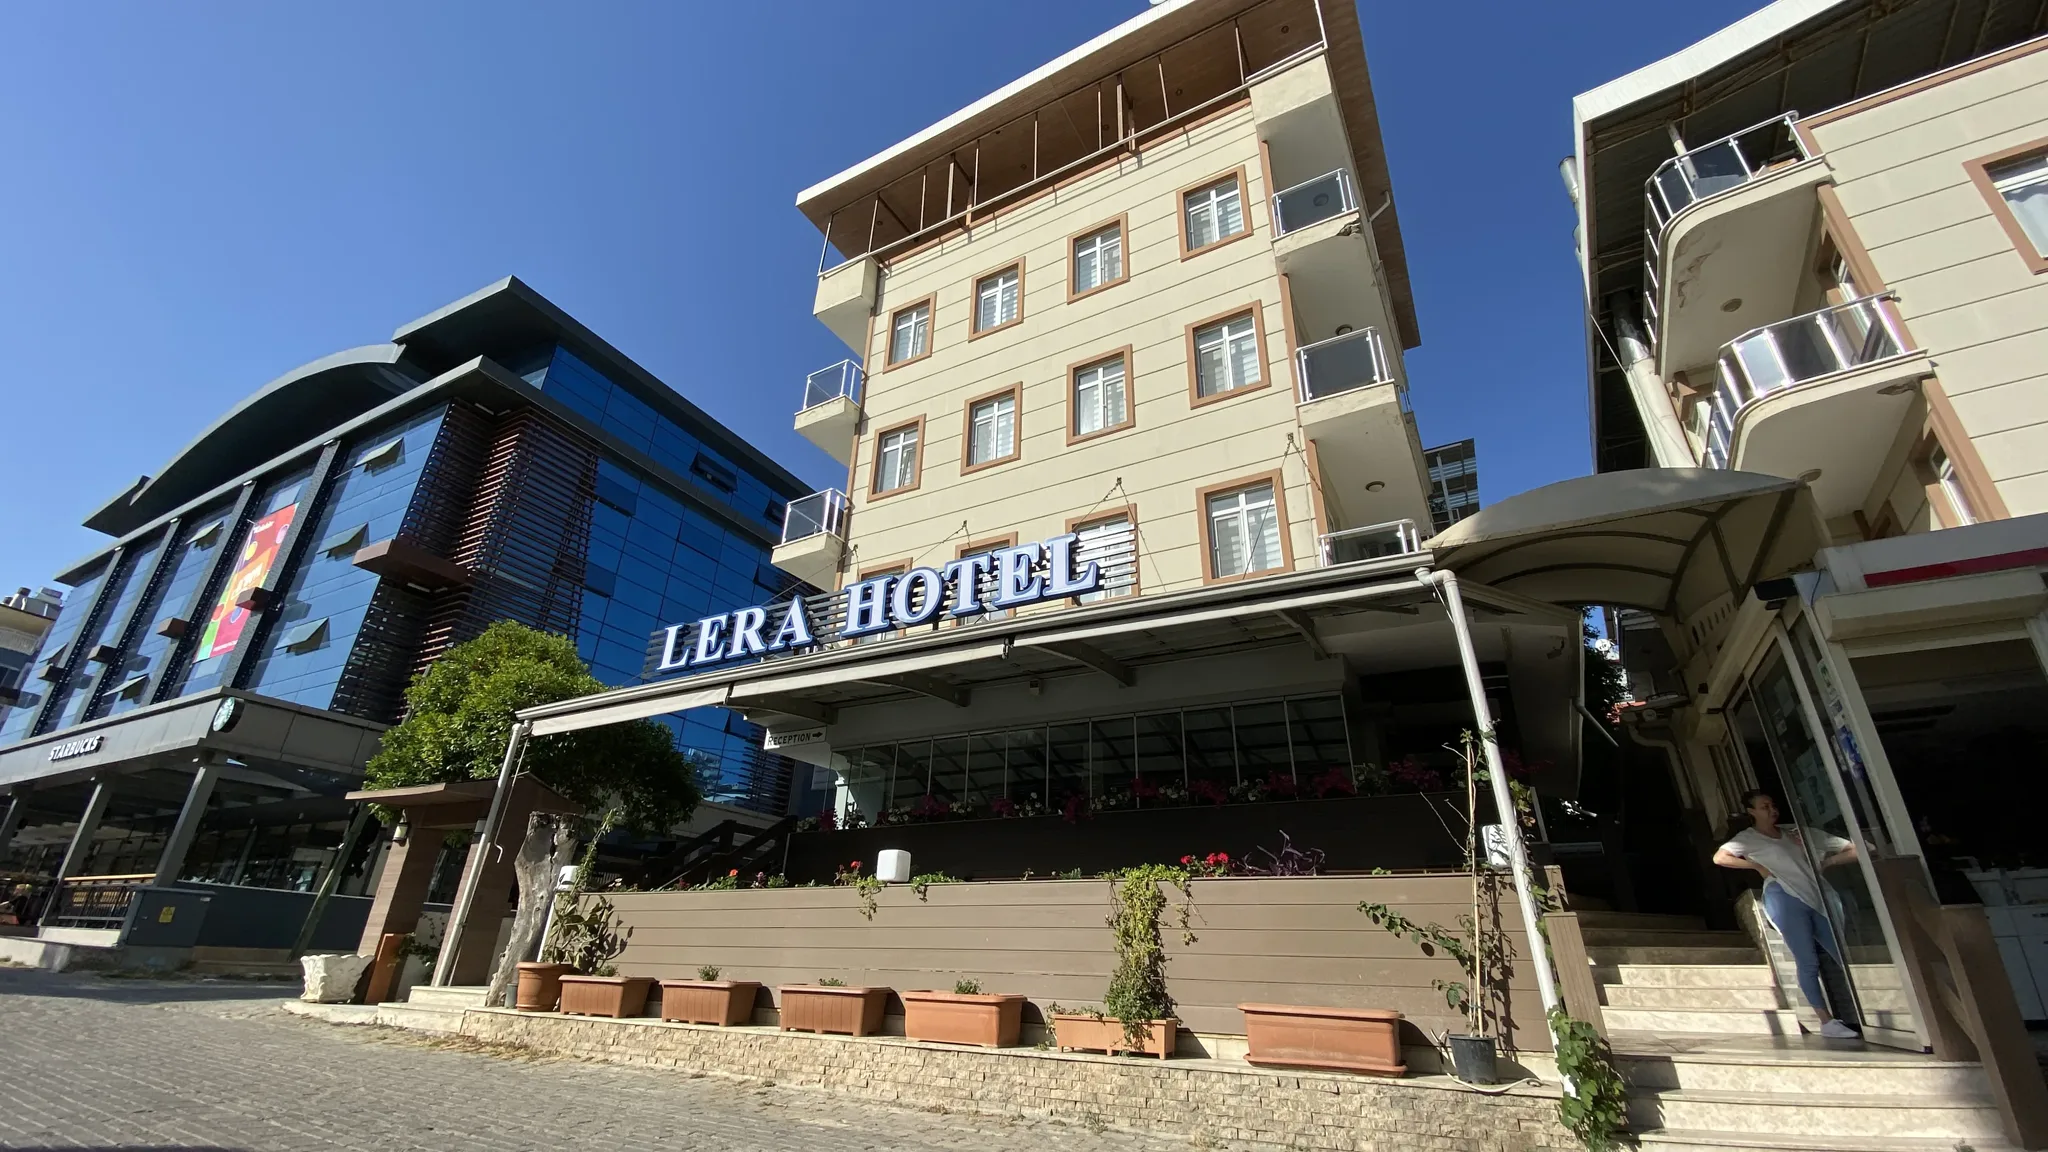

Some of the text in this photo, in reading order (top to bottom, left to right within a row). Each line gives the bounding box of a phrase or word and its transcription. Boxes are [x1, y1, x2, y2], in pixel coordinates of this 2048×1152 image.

[655, 532, 1099, 673] LERA HOTEL
[48, 735, 103, 762] STARBUCKS
[767, 732, 811, 746] RECEPTION
